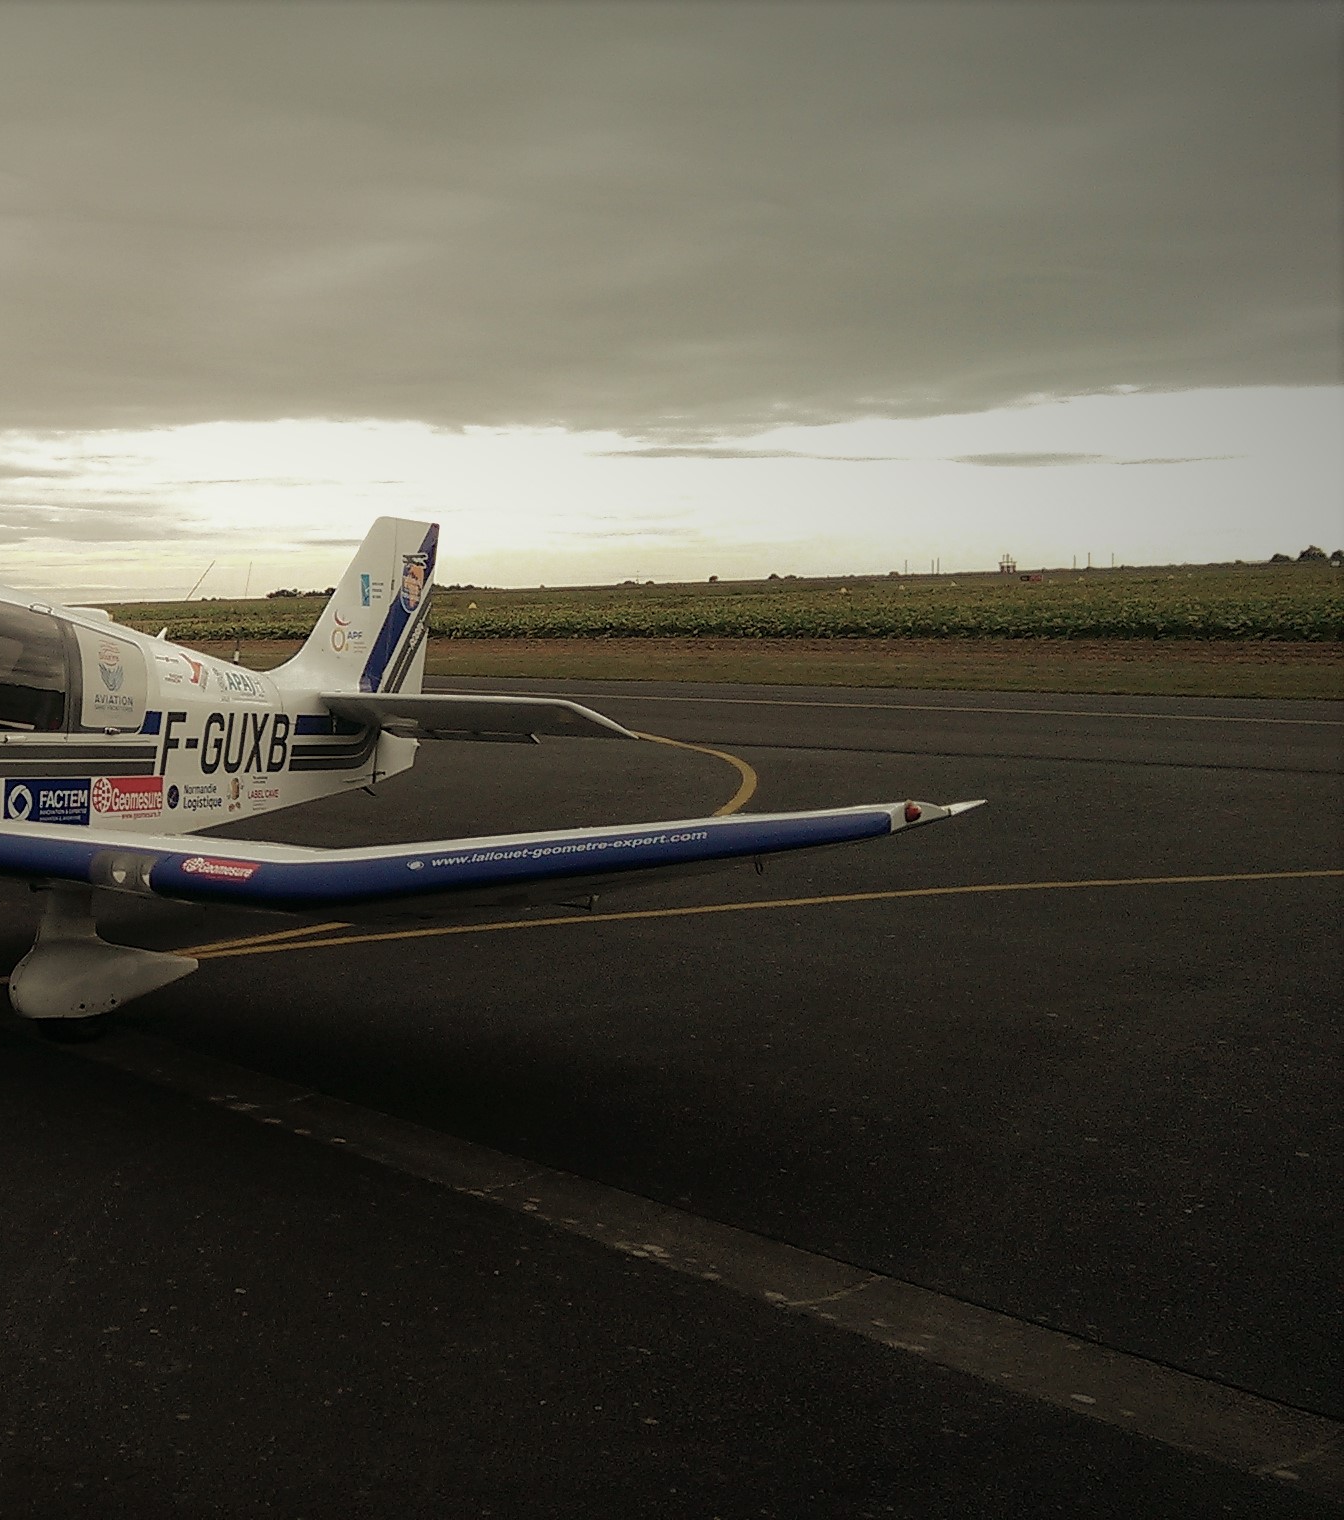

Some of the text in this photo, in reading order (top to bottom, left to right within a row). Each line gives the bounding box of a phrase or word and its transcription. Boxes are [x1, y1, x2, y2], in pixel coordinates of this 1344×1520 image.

[95, 694, 134, 706] AVIATION
[159, 712, 290, 775] F-GUXB
[183, 784, 217, 794] Normandie
[39, 789, 88, 808] FACTEM
[111, 787, 162, 811] Geomesure
[183, 796, 223, 812] Logistique
[430, 830, 708, 868] www.lallouet-geometre-expert.com
[198, 861, 253, 878] Geomesure
